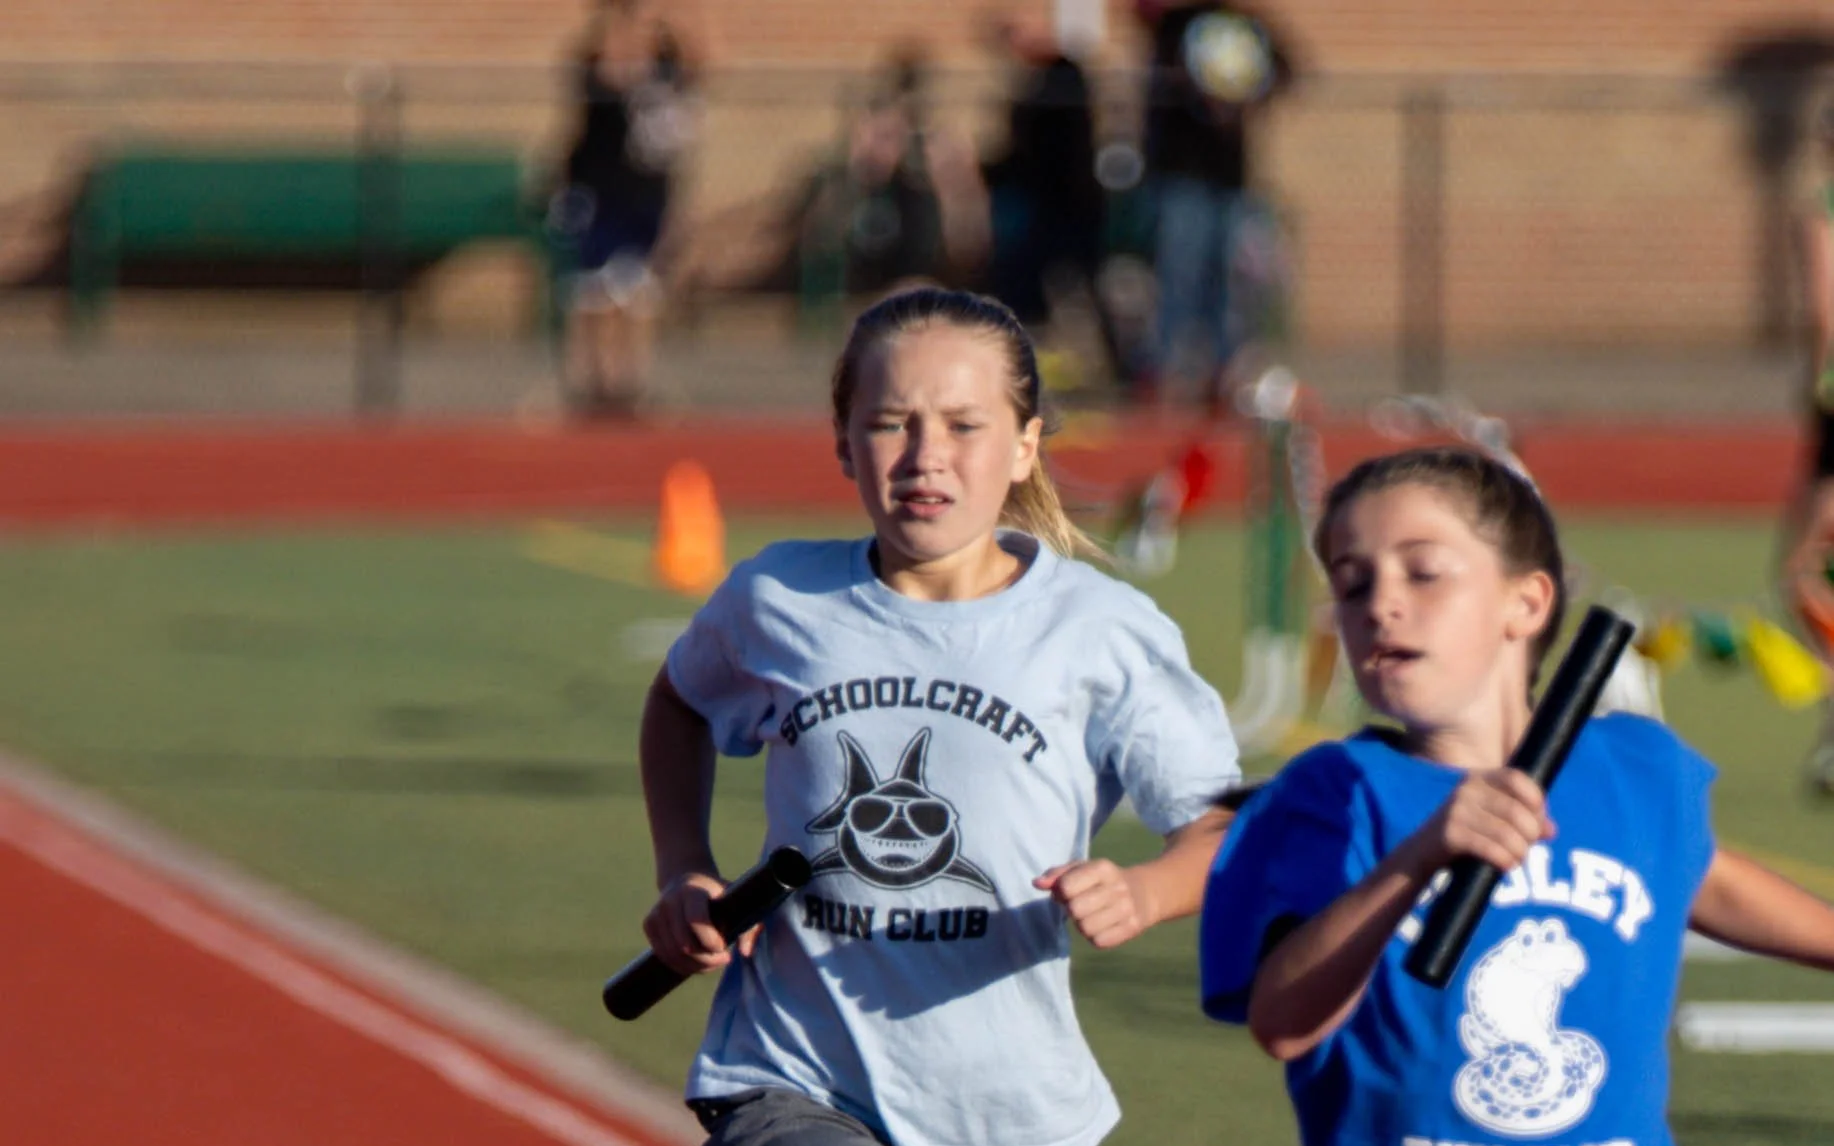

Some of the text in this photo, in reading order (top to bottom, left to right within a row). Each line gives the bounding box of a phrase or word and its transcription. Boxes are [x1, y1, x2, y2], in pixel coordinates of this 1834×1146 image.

[780, 676, 1048, 763] SCHOOLCRAFT
[802, 894, 990, 942] RUN CLUB
